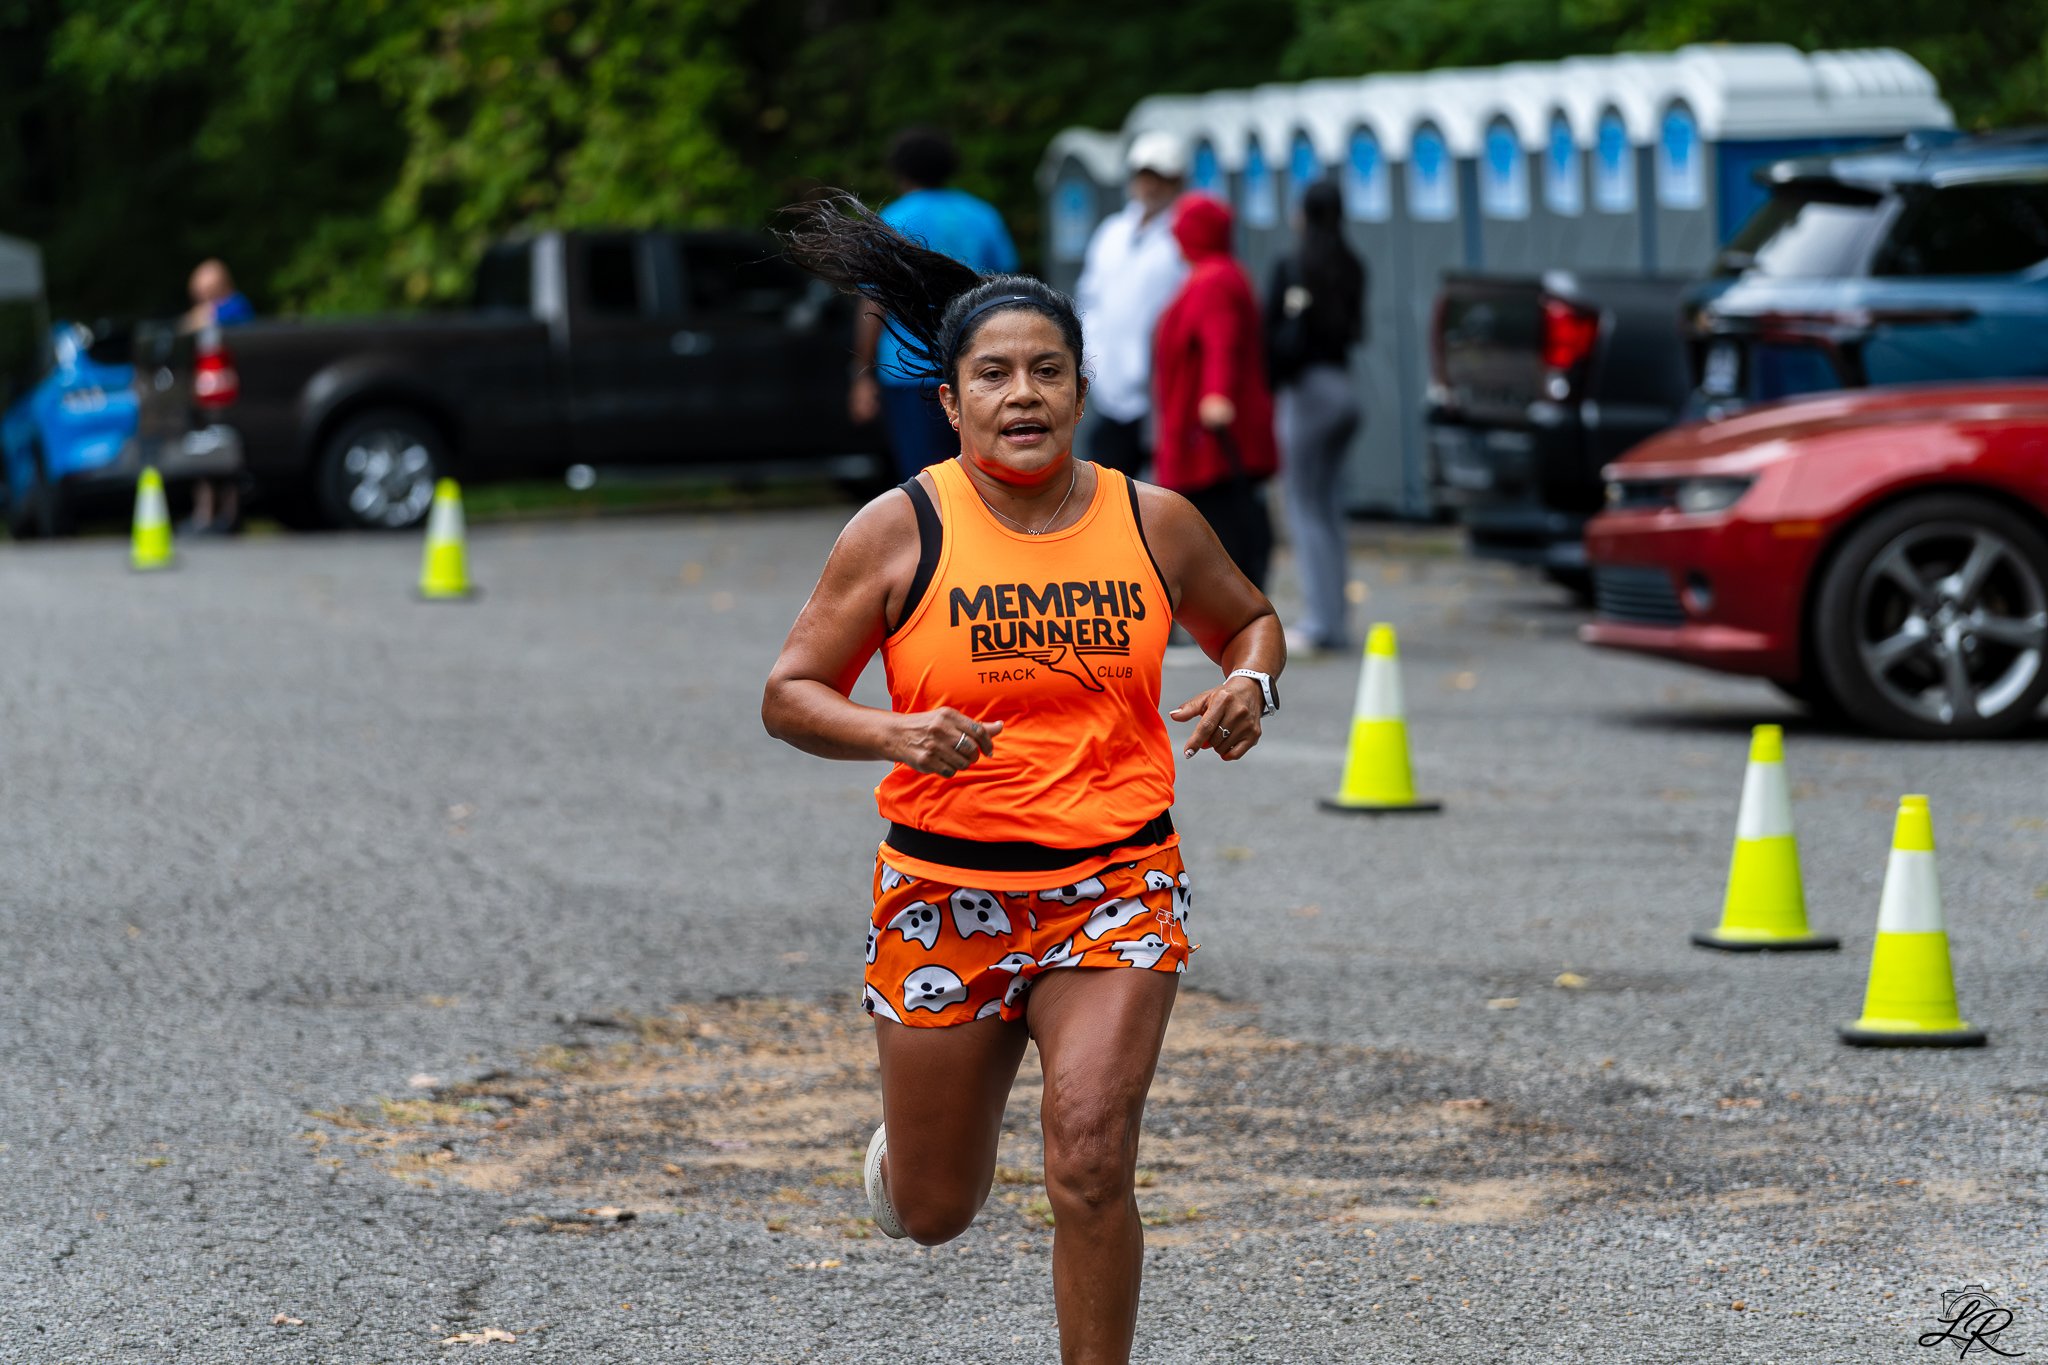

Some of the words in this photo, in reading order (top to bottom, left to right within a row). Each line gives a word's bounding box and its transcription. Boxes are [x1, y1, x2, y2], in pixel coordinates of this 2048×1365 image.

[949, 580, 1146, 627] MEMPHIS
[971, 618, 1130, 652] RUNNERS
[977, 668, 1036, 684] TRACK
[1097, 665, 1133, 679] CLUB
